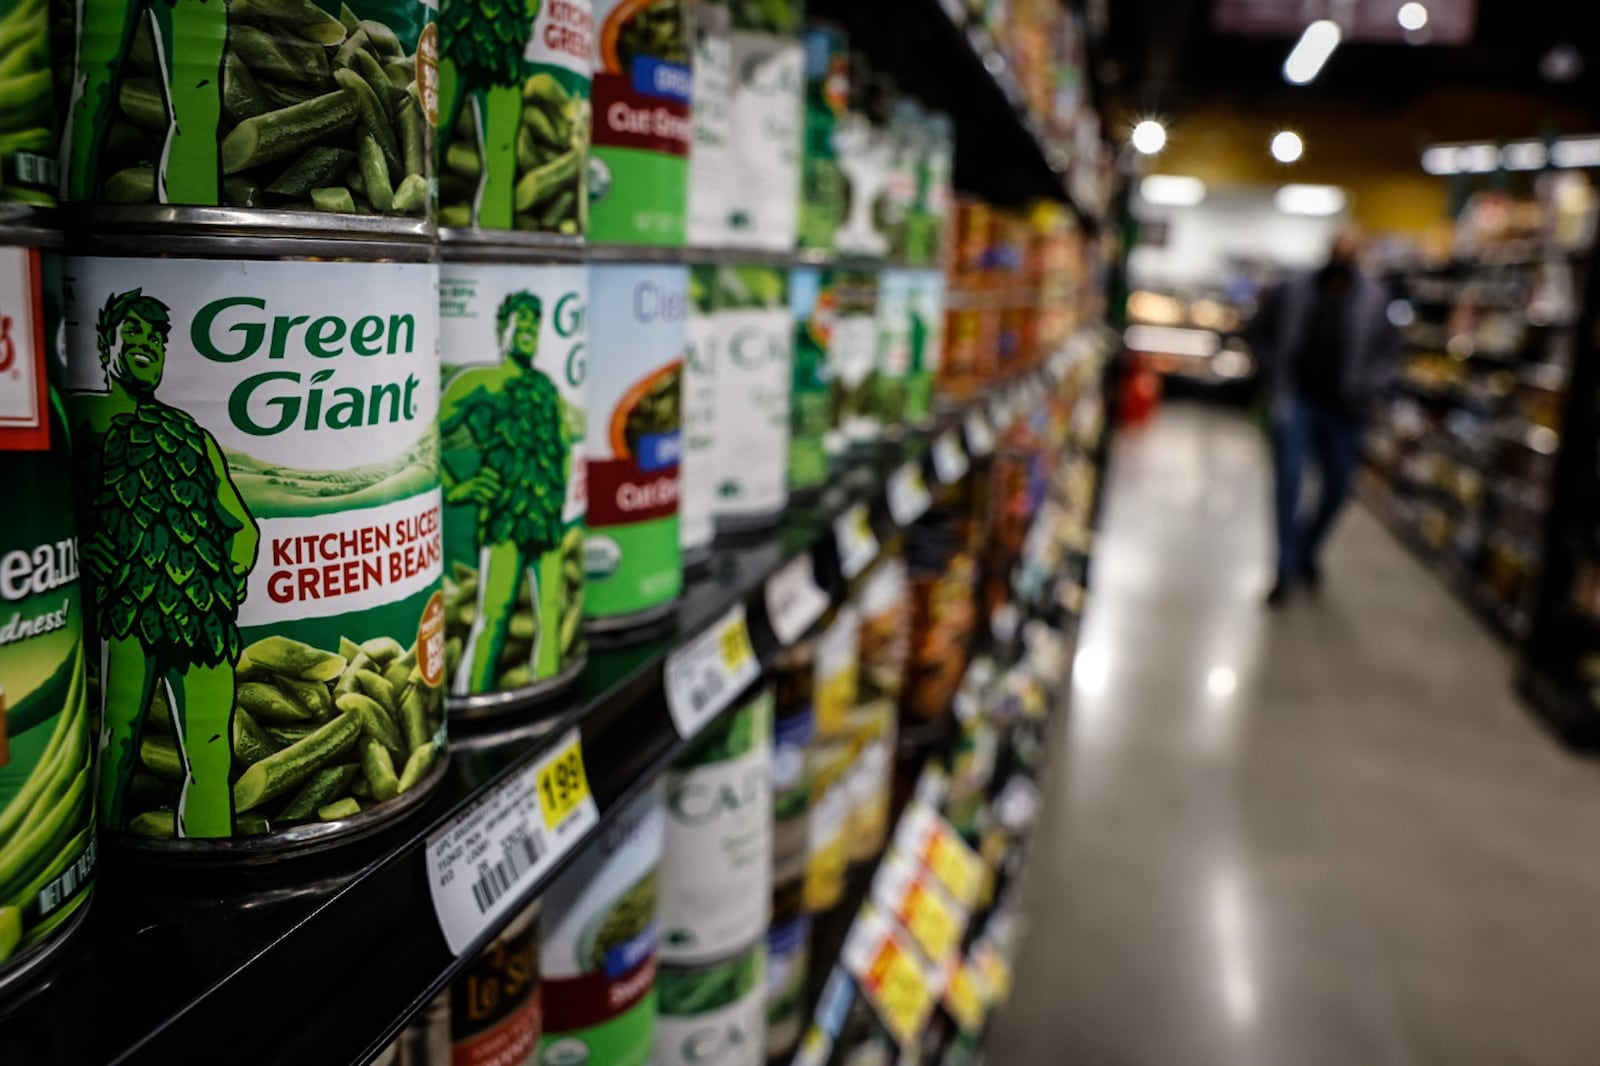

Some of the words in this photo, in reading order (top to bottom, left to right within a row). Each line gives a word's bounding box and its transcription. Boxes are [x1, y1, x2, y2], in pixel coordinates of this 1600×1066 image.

[190, 296, 416, 363] Green
[228, 369, 419, 436] Giant
[267, 556, 382, 604] GREEN
[389, 533, 441, 583] BEANS
[272, 523, 391, 566] KITCHEN
[395, 507, 440, 546] SLICED
